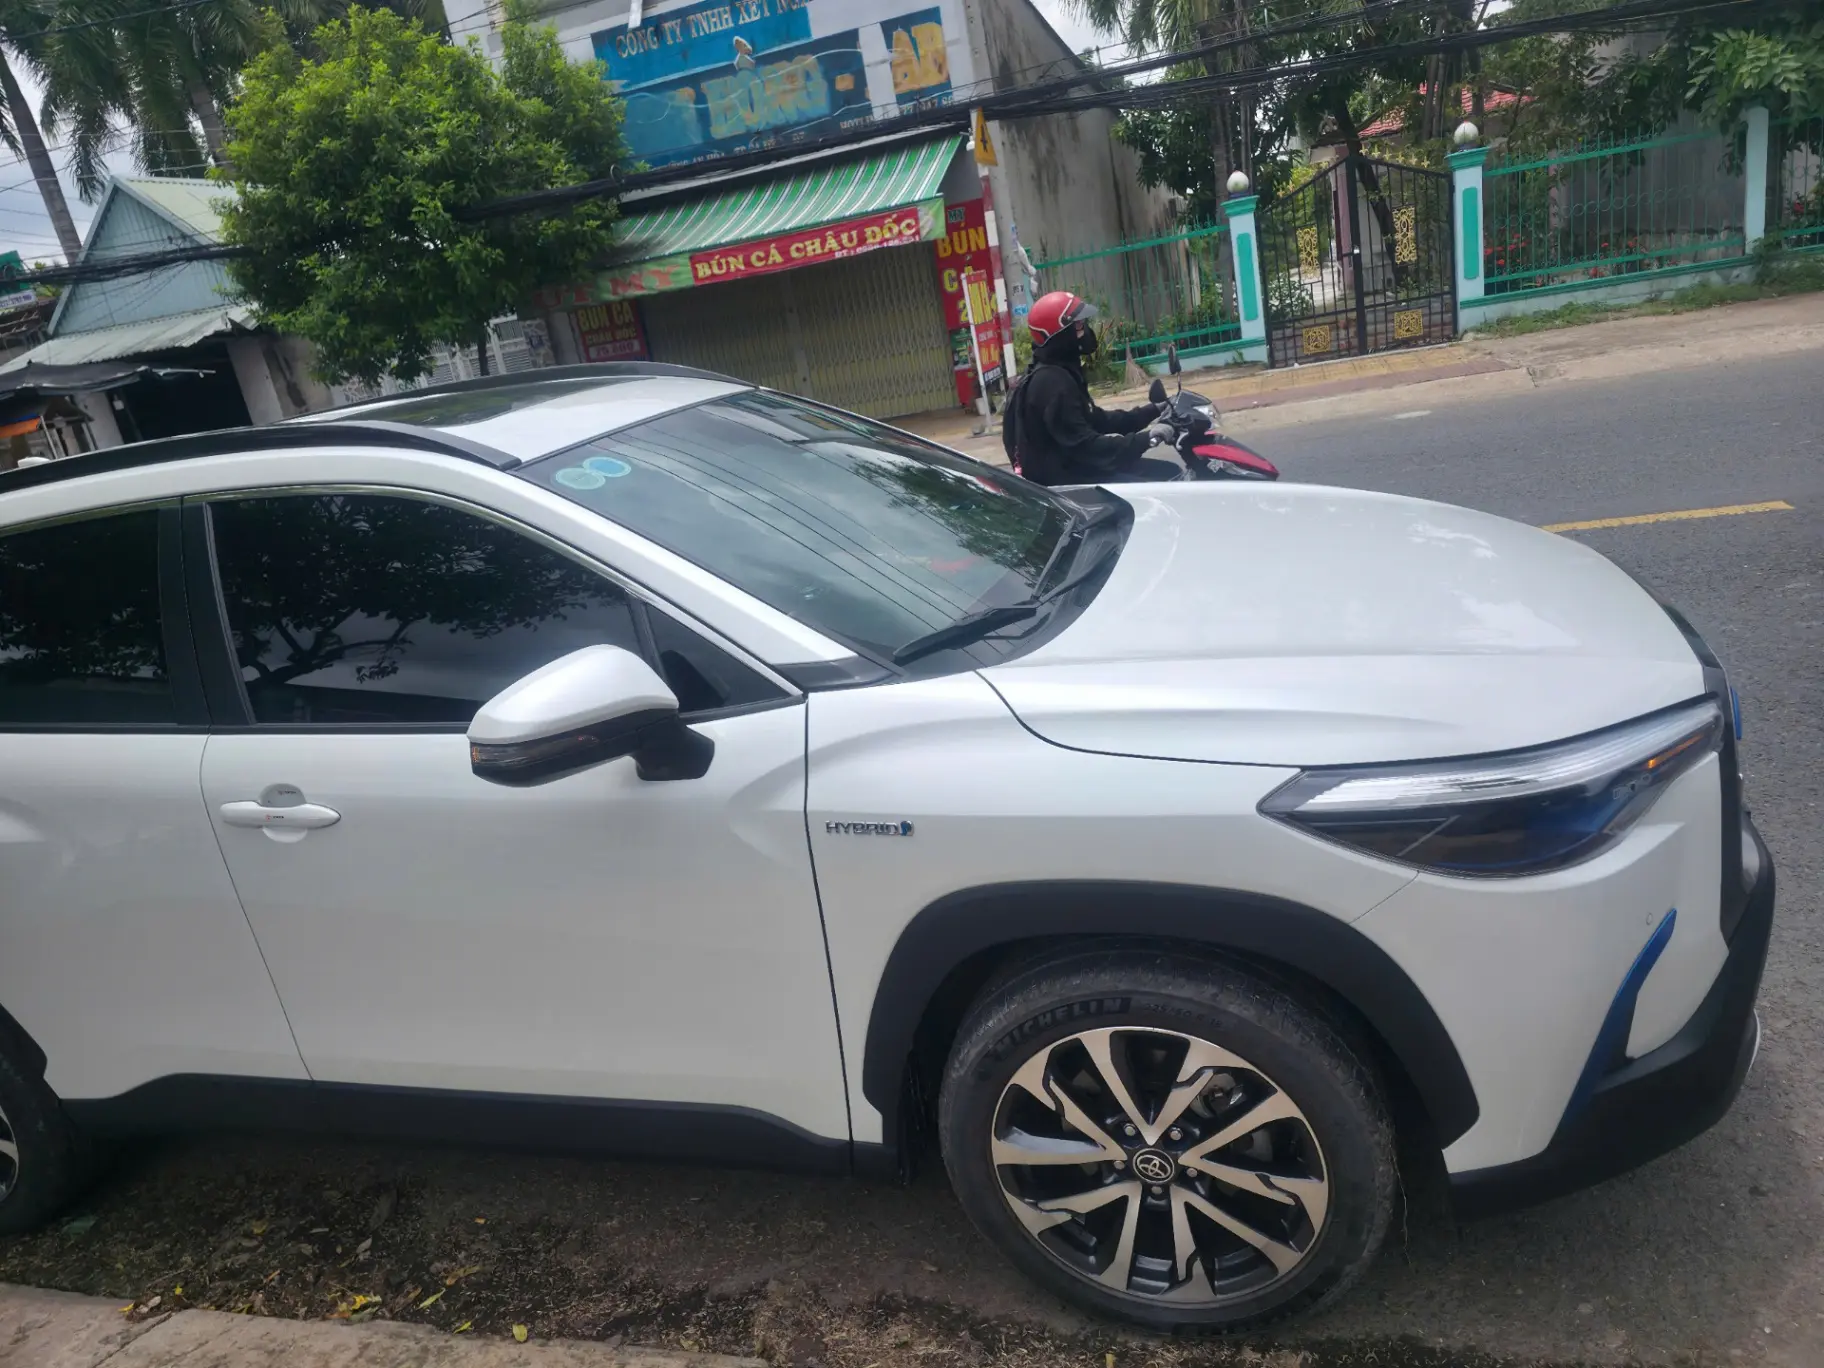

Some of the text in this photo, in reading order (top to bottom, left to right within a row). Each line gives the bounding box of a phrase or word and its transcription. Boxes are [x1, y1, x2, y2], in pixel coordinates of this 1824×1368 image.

[664, 19, 684, 46] TY
[688, 6, 735, 38] TNHH
[695, 254, 745, 279] BÚN
[750, 244, 784, 268] CÁ
[790, 230, 858, 259] CHÂU
[864, 214, 917, 244] ĐỐC
[937, 222, 986, 258] BÚN
[825, 820, 900, 836] HYBRID
[993, 997, 1126, 1059] MICHELIN
